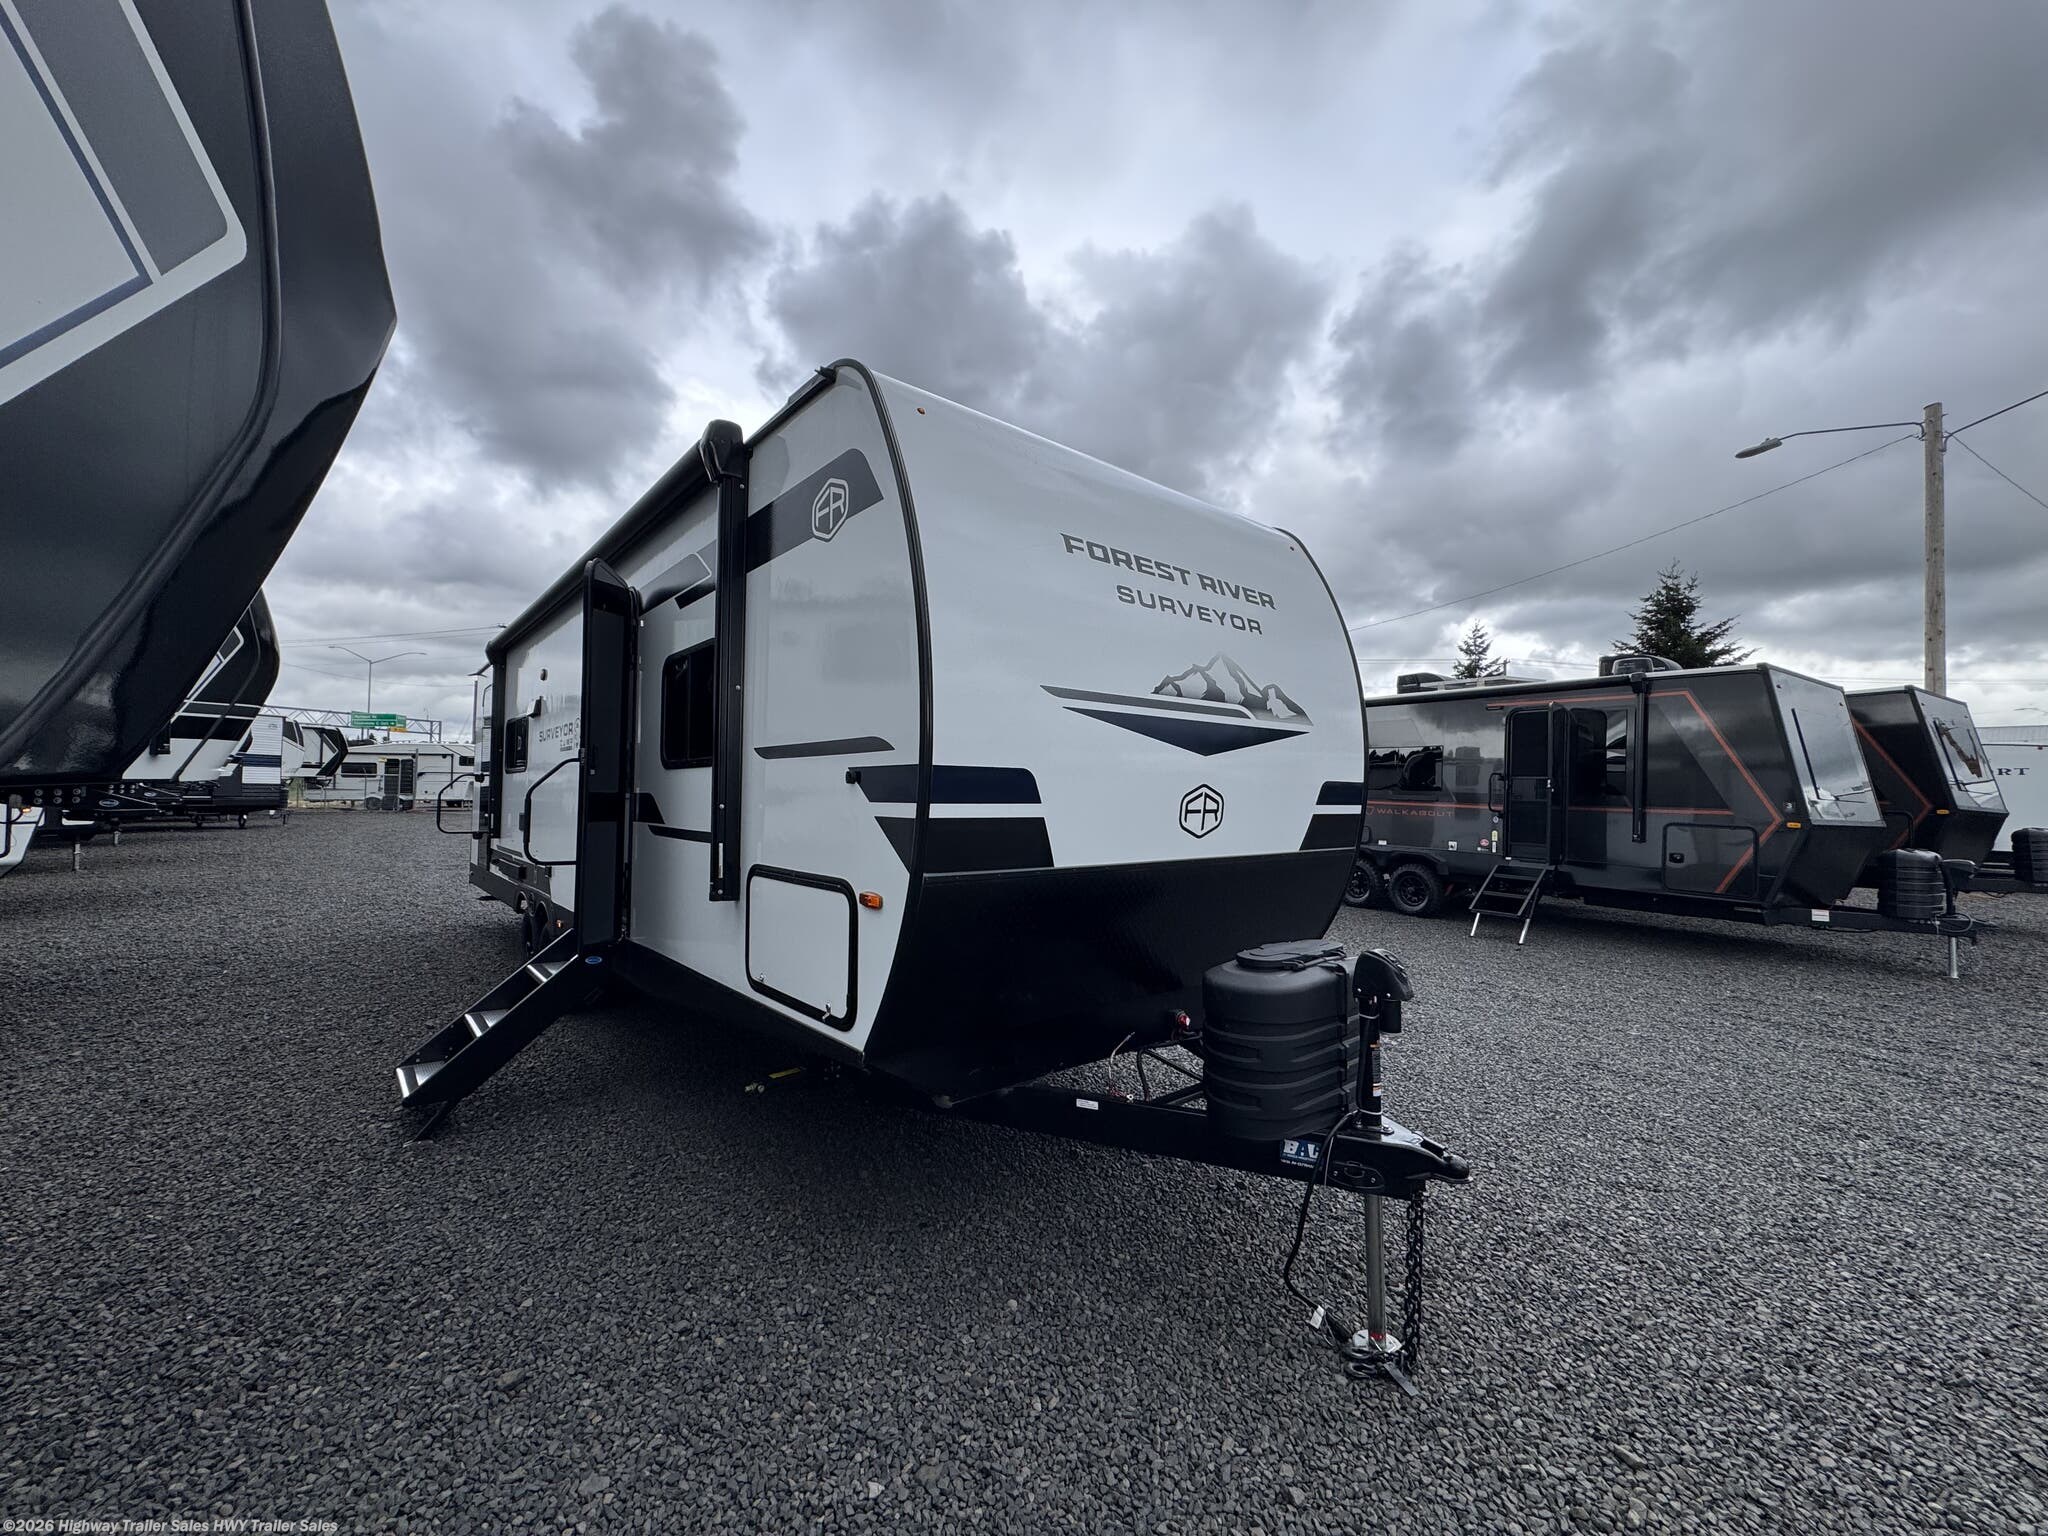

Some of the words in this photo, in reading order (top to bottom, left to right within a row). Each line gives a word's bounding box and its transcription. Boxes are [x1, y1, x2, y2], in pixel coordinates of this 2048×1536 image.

[1060, 533, 1191, 586] FOREST
[1196, 572, 1277, 611] RIVER
[1116, 584, 1263, 635] SURVEYOR
[539, 722, 574, 743] SURVEYOR
[1997, 767, 2030, 776] RT
[1376, 807, 1454, 817] WALKABOUT
